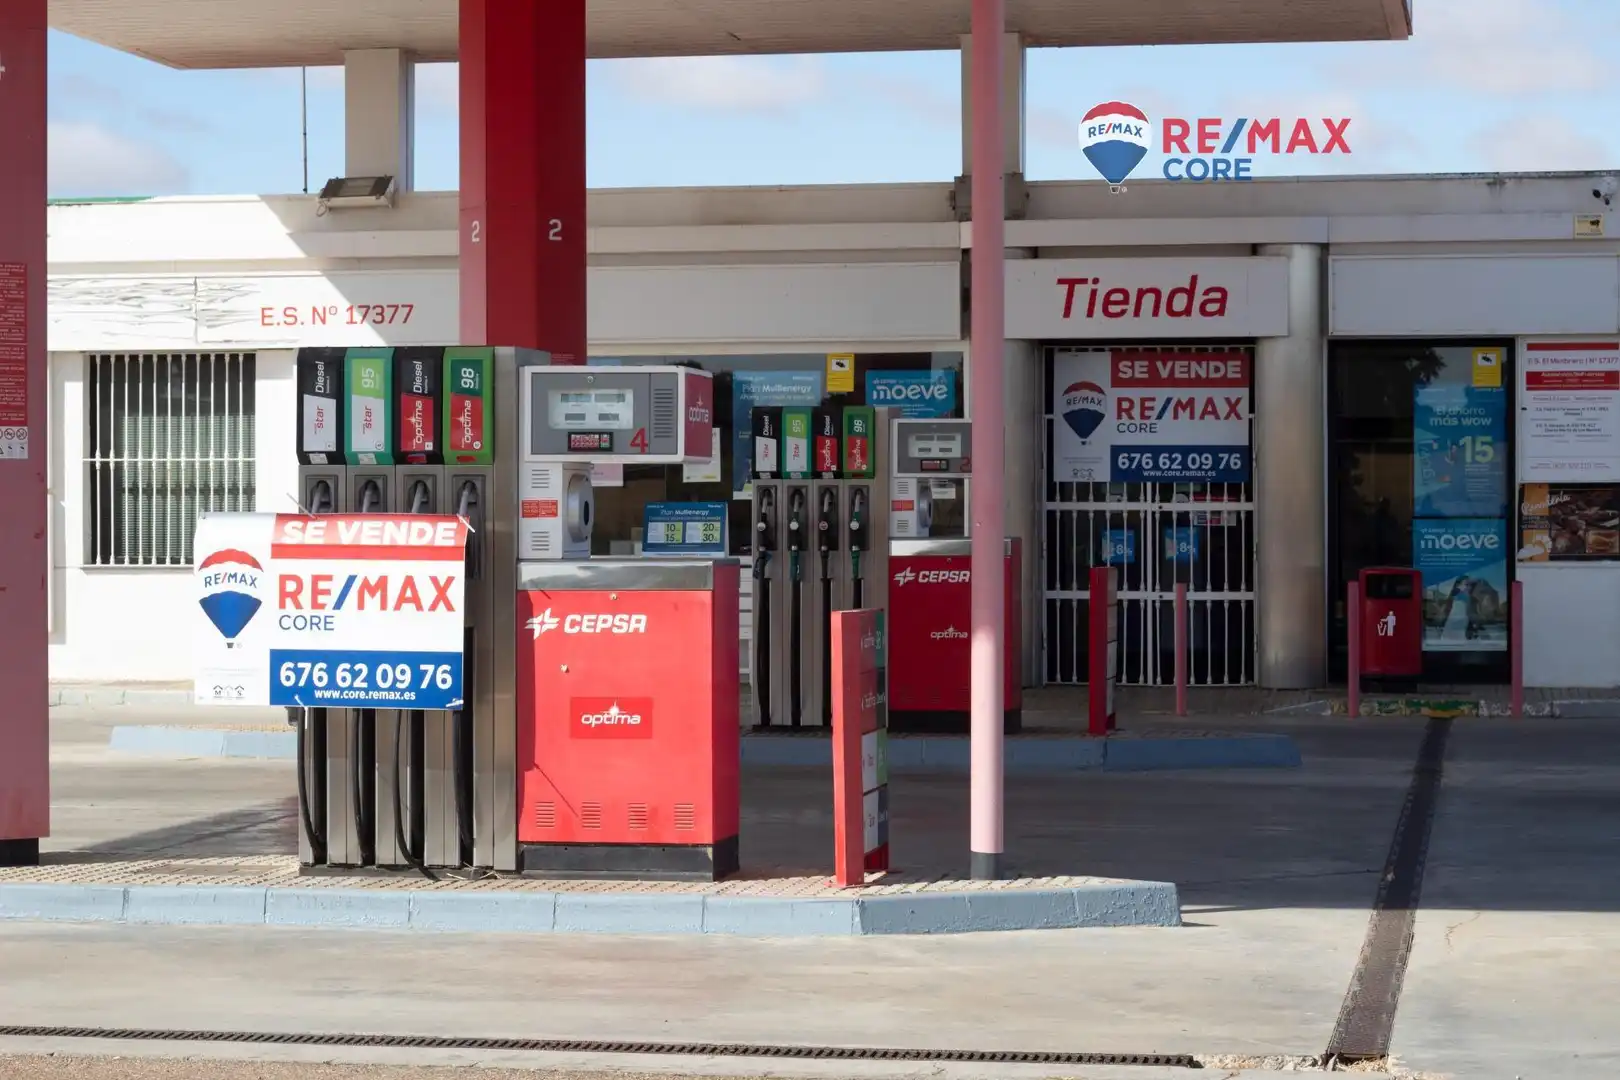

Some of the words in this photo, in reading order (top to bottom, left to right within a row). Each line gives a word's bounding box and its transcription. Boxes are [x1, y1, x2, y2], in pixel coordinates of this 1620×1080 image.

[471, 220, 480, 243] 2
[548, 219, 562, 241] 2
[1056, 275, 1228, 318] Tienda
[260, 306, 304, 326] E.S.
[346, 304, 414, 325] 17377
[315, 361, 325, 394] Diesel
[362, 368, 375, 389] 95
[413, 361, 423, 394] Diesel
[461, 367, 475, 389] 98
[1118, 360, 1149, 379] SE
[1155, 360, 1242, 379] VENDE
[762, 383, 812, 394] Multienergy
[872, 384, 948, 400] moeve
[1066, 395, 1103, 407] RE/MAX
[1116, 397, 1243, 421] RE/MAX
[1448, 405, 1486, 416] ahorro
[316, 406, 324, 429] star
[364, 406, 373, 429] star
[415, 400, 427, 444] optima
[464, 400, 476, 443] optima
[853, 419, 863, 433] 98
[1429, 414, 1458, 426] más
[1461, 416, 1492, 426] wow
[1117, 422, 1158, 434] CORE
[630, 427, 649, 454] 4
[1458, 435, 1494, 464] 15
[1117, 453, 1153, 470] 676
[1158, 453, 1182, 470] 62
[1187, 453, 1213, 470] 09
[1218, 453, 1241, 470] 76
[282, 520, 324, 545] SE
[337, 521, 457, 546] VENDE
[703, 523, 715, 532] 20
[1420, 534, 1499, 550] moeve
[204, 572, 258, 589] RE/MAX
[918, 570, 971, 583] CEPSA
[278, 574, 456, 612] RE/MAX
[278, 615, 335, 631] CORE
[564, 614, 647, 634] CEPSA
[930, 630, 968, 640] optima
[279, 661, 328, 687] 676
[336, 663, 368, 688] 62
[376, 664, 412, 689] 09
[419, 664, 452, 689] 76
[314, 689, 416, 701] www.core.remax.es
[581, 711, 641, 728] optima
